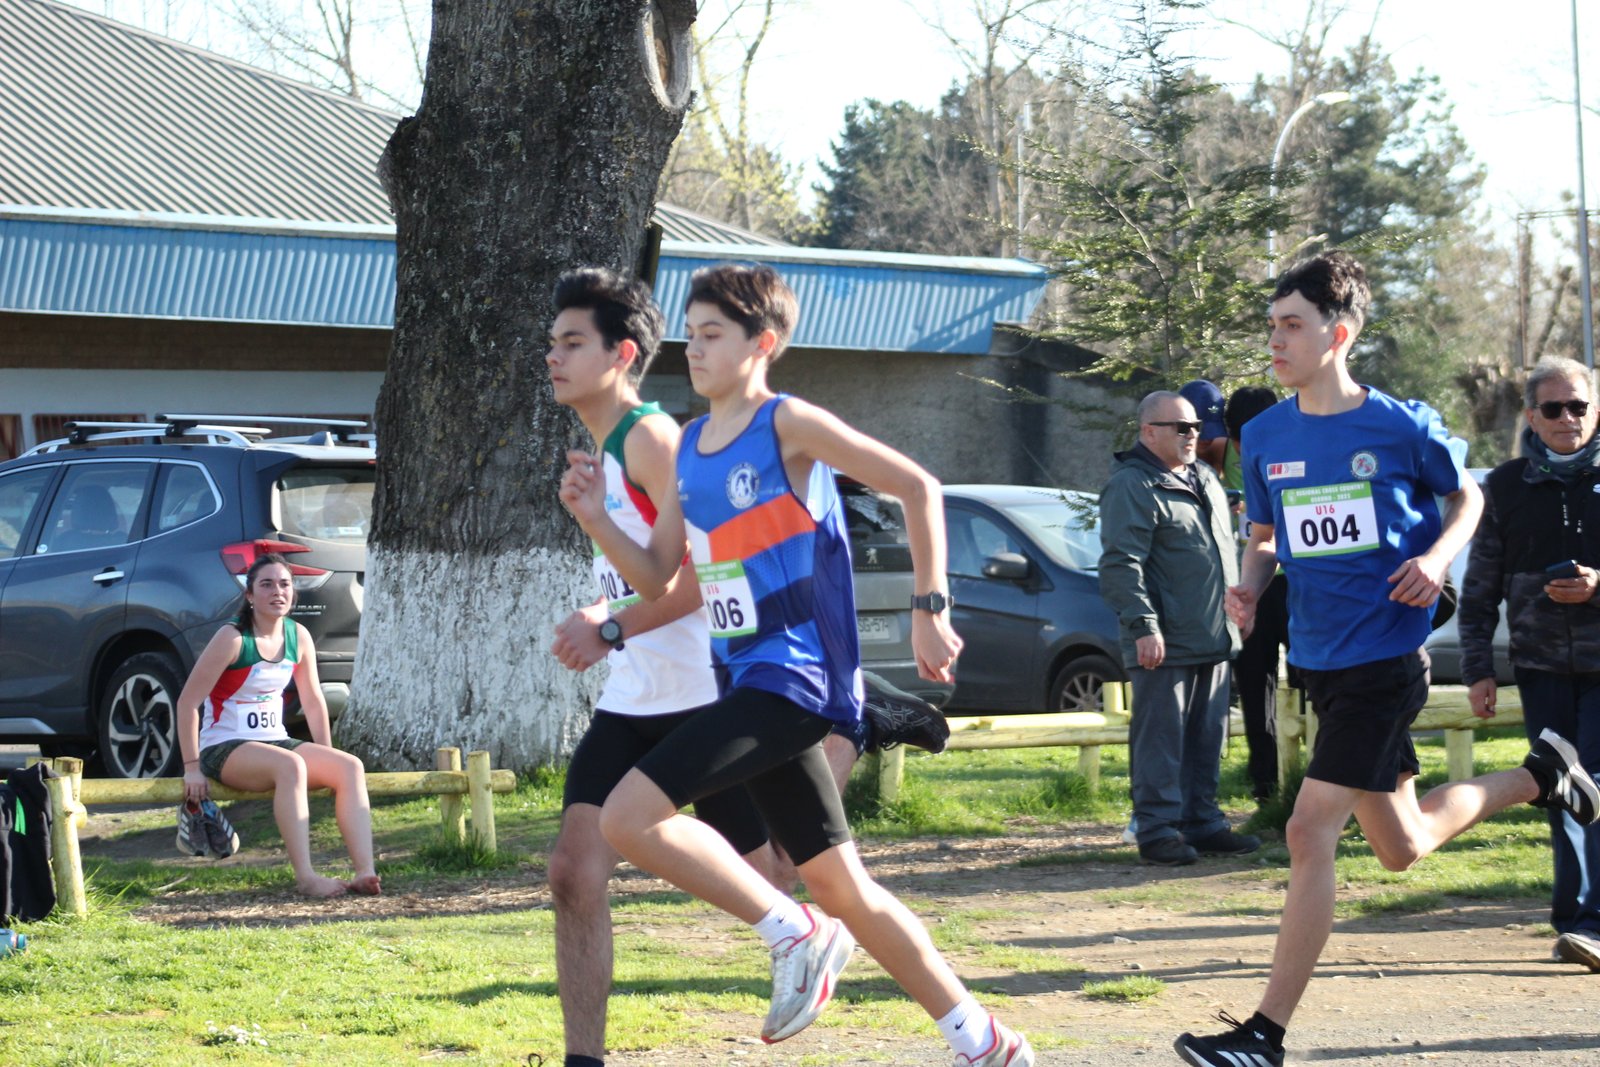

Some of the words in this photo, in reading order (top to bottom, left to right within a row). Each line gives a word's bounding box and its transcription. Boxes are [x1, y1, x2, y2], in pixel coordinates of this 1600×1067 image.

[1315, 504, 1335, 515] U16
[1300, 513, 1361, 547] 004
[247, 711, 277, 729] 050
